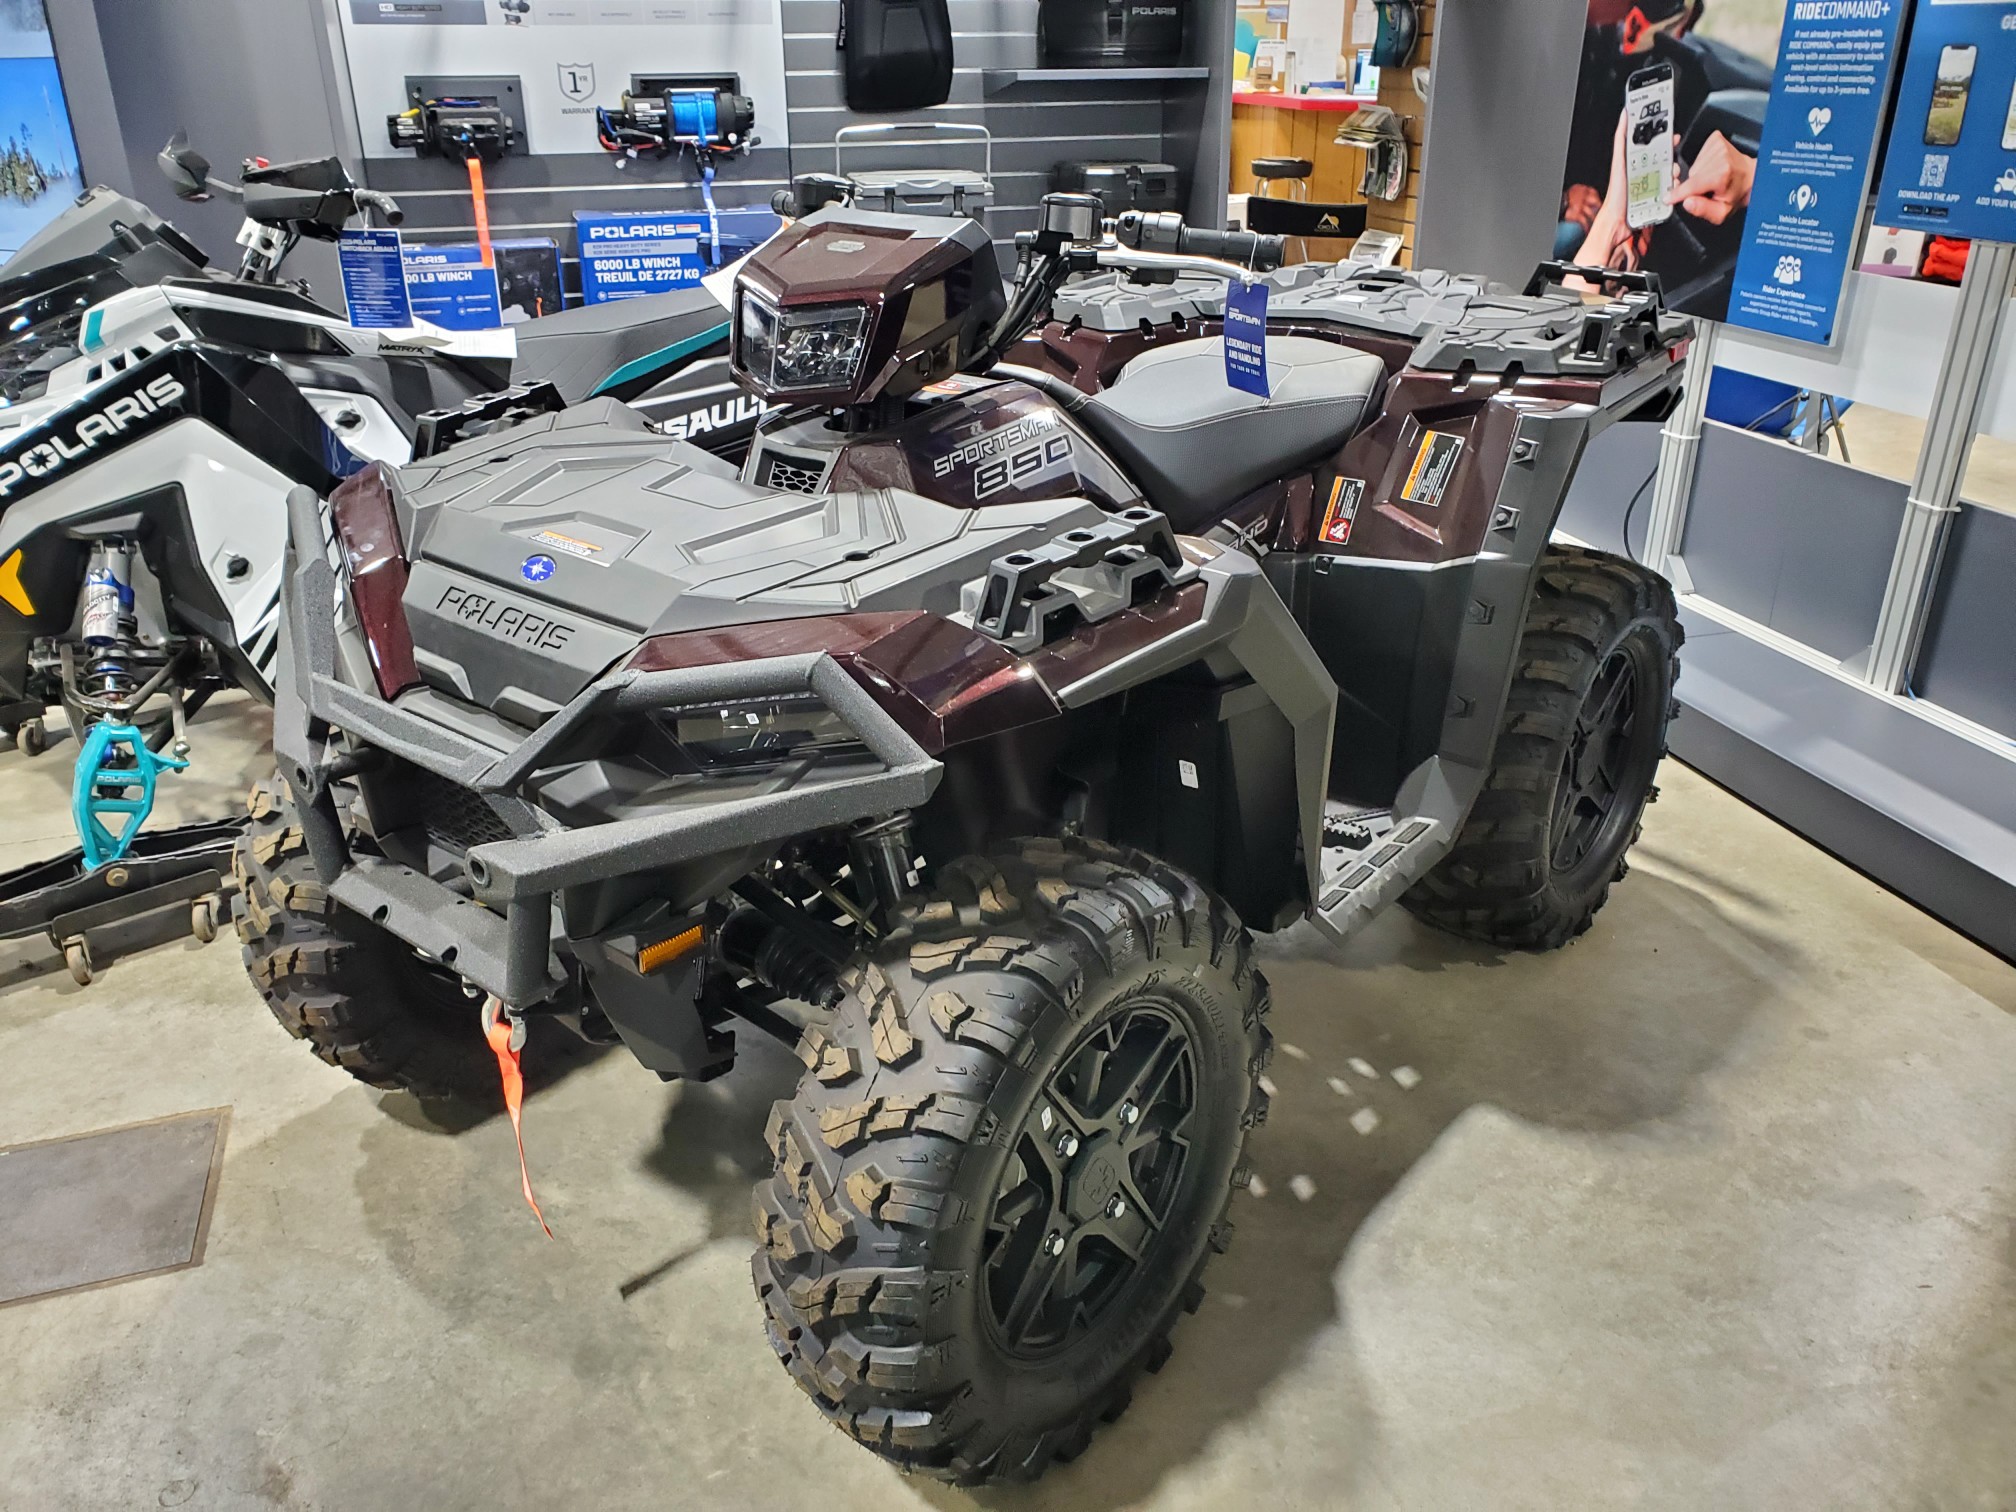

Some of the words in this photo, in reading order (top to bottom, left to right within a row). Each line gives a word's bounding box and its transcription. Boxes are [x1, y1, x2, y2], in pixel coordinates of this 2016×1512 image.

[1132, 7, 1177, 16] POLARIS
[567, 71, 582, 94] 1
[1898, 189, 1933, 200] DOWNLOAD
[1933, 192, 1946, 202] THE
[1945, 193, 1960, 203] APP
[1975, 196, 1991, 206] ADD
[1991, 198, 2009, 208] YOUR
[1779, 214, 1797, 224] Vehicle
[1797, 217, 1820, 227] Locator
[590, 224, 677, 239] POLARIS
[402, 255, 448, 265] OLARIS
[594, 259, 624, 270] 6000
[625, 258, 641, 269] LB
[643, 256, 681, 269] WINCH
[406, 274, 419, 283] 00
[421, 273, 435, 282] LB
[437, 271, 473, 282] WINCH
[596, 270, 637, 284] TREUIL
[638, 270, 654, 282] DE
[655, 269, 682, 281] 2727
[684, 268, 700, 280] KG
[1762, 284, 1776, 294] Rider
[1776, 287, 1806, 300] Experience
[1229, 312, 1261, 325] SPORTSMAN
[378, 343, 425, 354] MATRYX
[1226, 337, 1252, 352] LEGENDARY
[1251, 342, 1262, 355] RIDE
[1229, 349, 1238, 360] AND
[1238, 351, 1260, 367] HANDLING
[653, 394, 768, 440] SAULT
[0, 373, 186, 496] POLARIS
[933, 408, 1062, 478] SPORTSMAN
[974, 431, 1074, 500] 850
[436, 586, 576, 649] POLARIS
